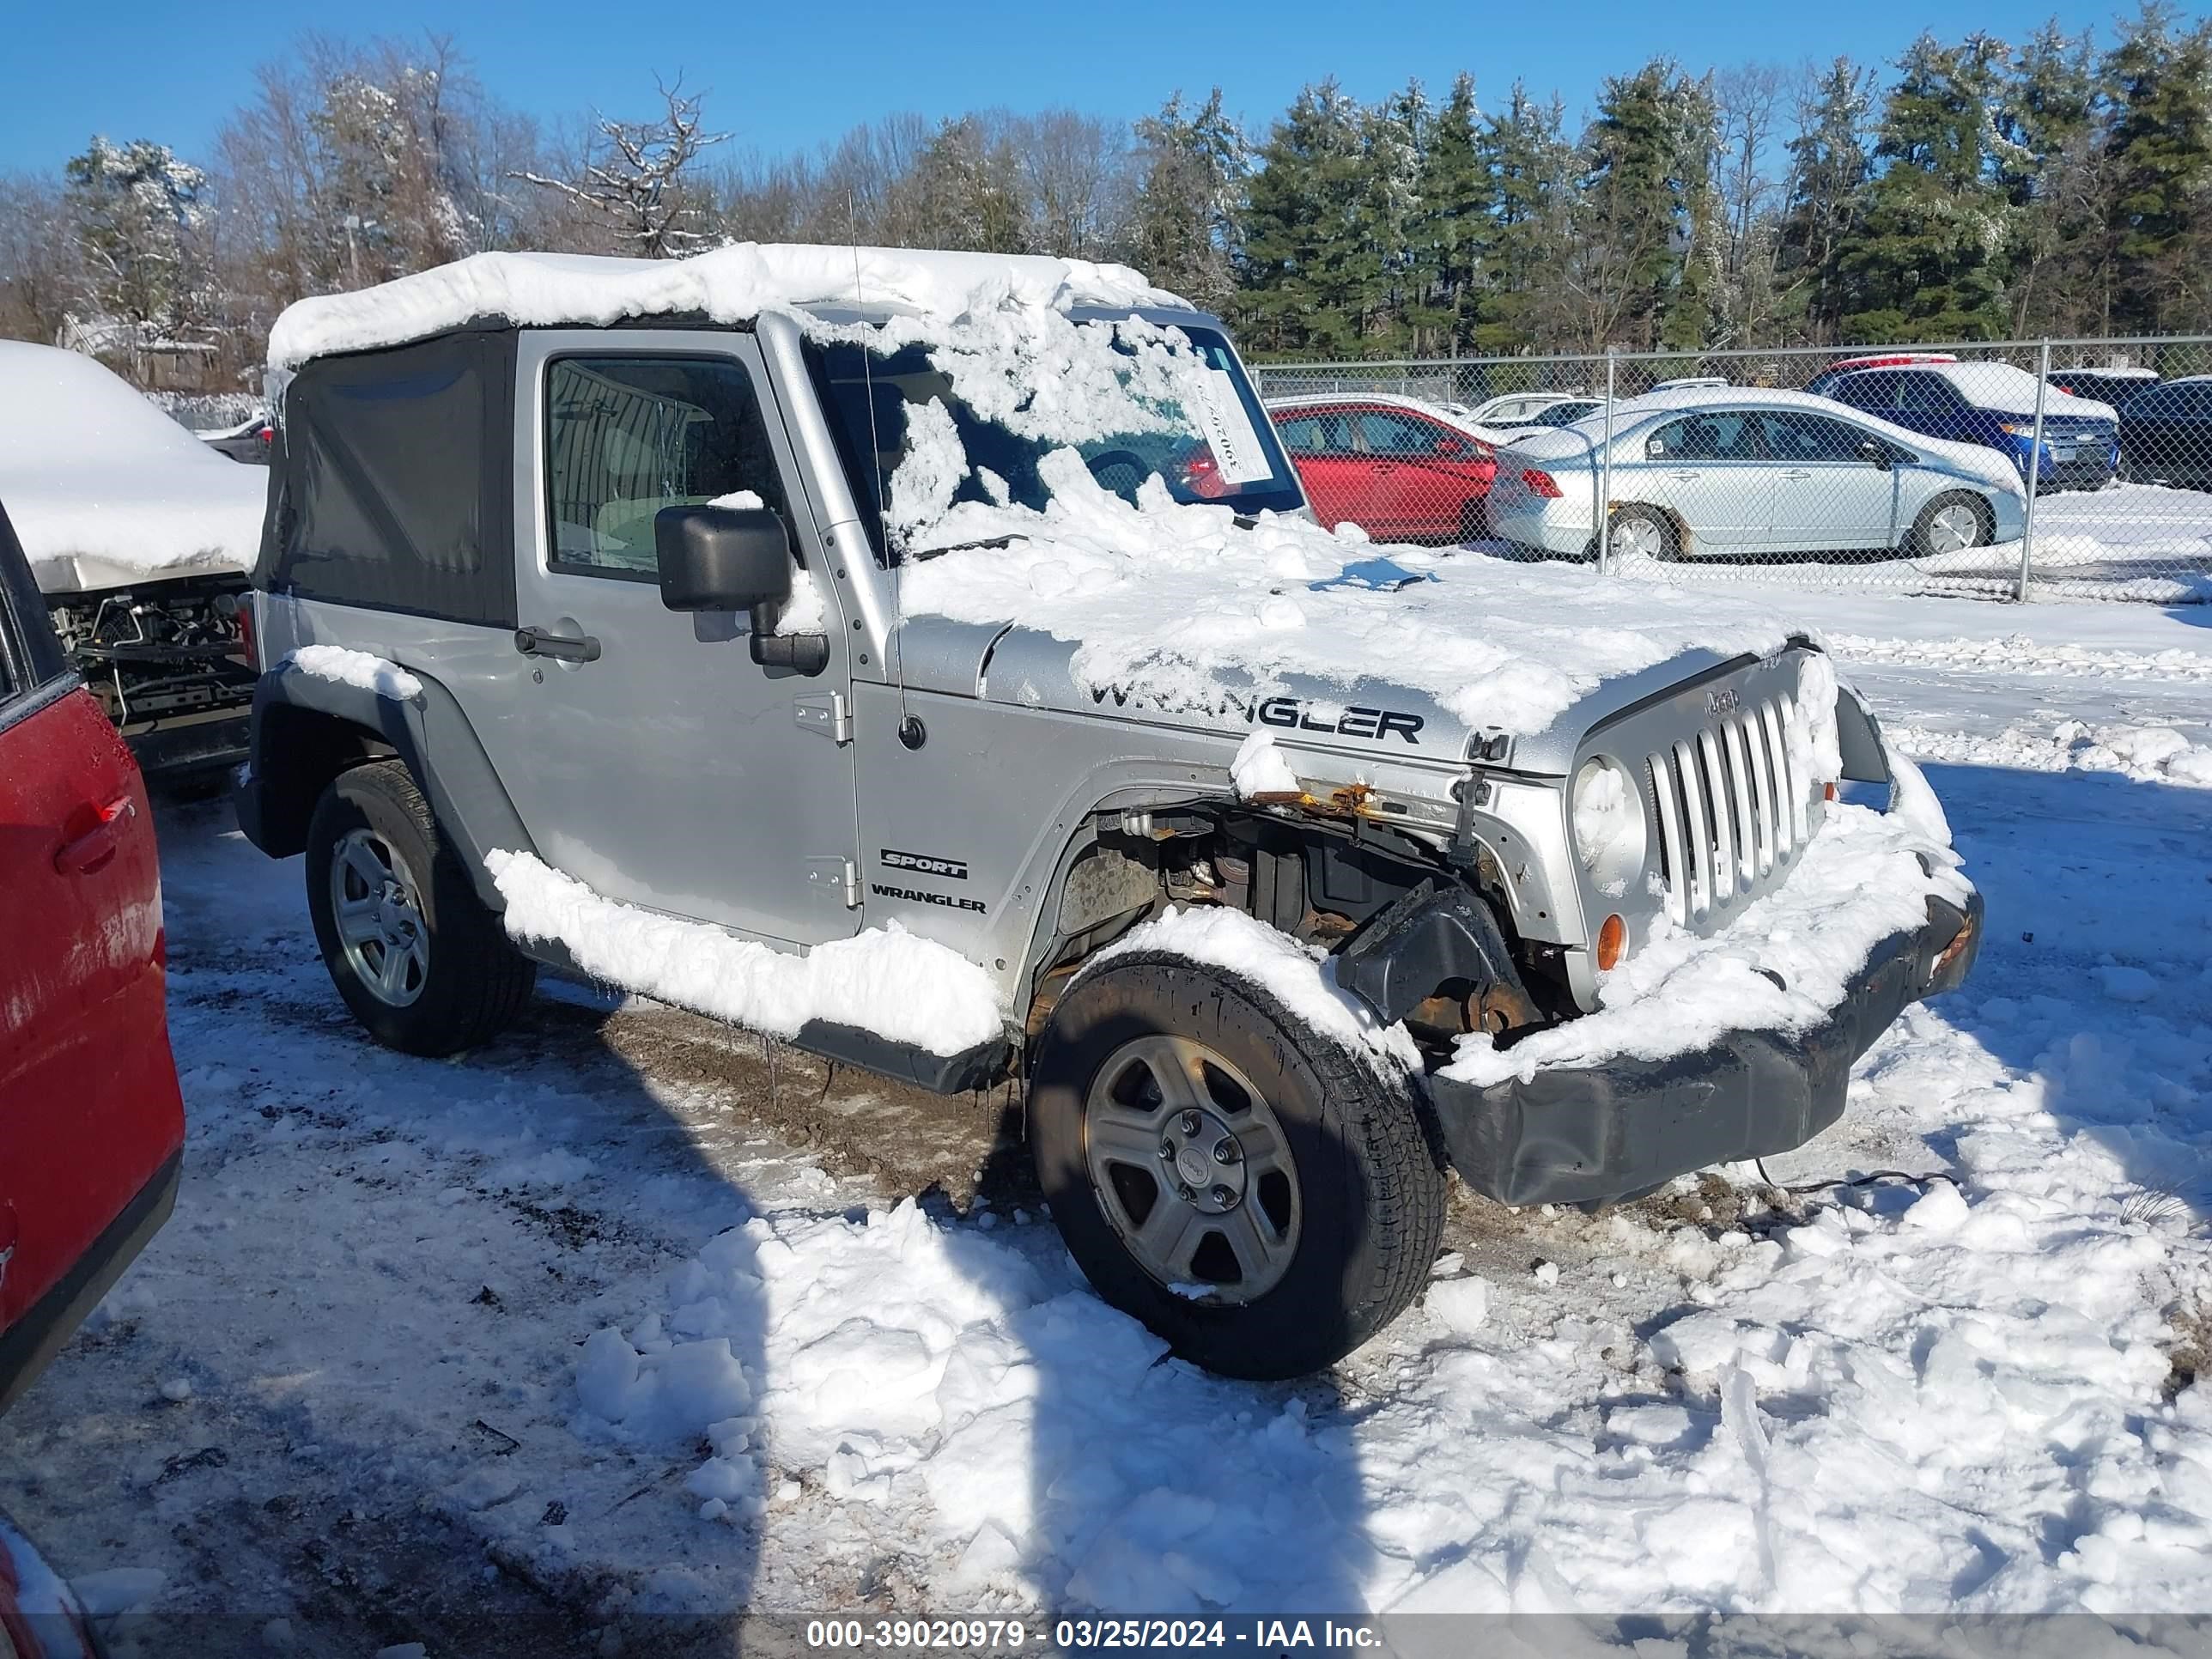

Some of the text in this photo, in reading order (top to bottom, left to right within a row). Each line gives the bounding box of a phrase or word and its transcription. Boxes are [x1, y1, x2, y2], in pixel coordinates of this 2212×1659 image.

[1090, 680, 1425, 744] WNGLER
[1705, 688, 1741, 718] Jeep
[885, 853, 968, 876] SPORT
[871, 883, 987, 915] WRANGLER
